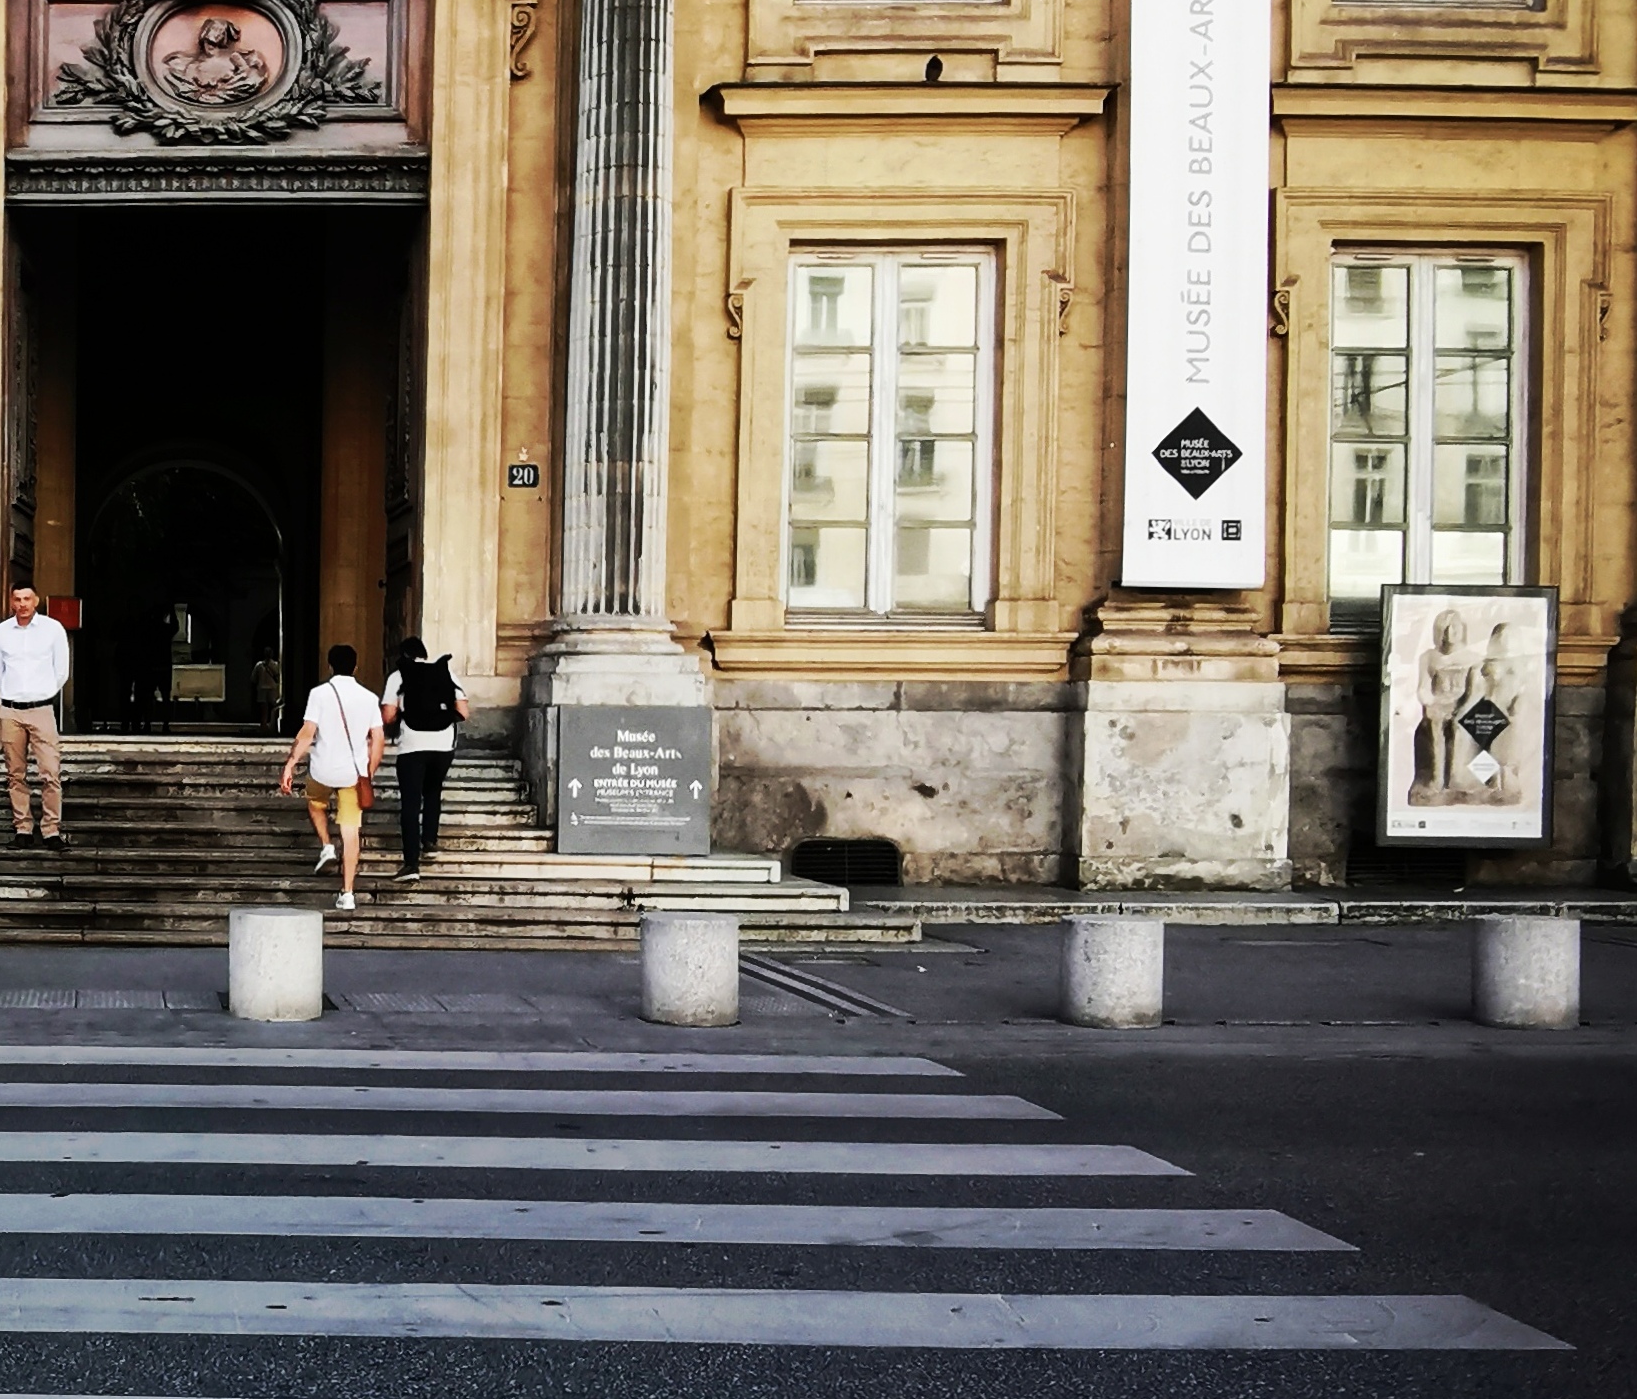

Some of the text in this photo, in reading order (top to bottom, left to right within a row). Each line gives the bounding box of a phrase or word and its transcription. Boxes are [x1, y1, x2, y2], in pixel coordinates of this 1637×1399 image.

[1187, 189, 1212, 254] DES
[1180, 268, 1211, 384] MUSÉE
[1181, 438, 1209, 448] MUSÉE
[1160, 449, 1178, 458] DES
[512, 467, 534, 485] 20
[1173, 528, 1211, 540] LYON
[617, 729, 656, 742] Musée
[590, 746, 682, 759] des Beaux-Arts
[612, 763, 659, 778] de Lyon
[593, 778, 678, 788] ENTRÉE DU MUSÉE
